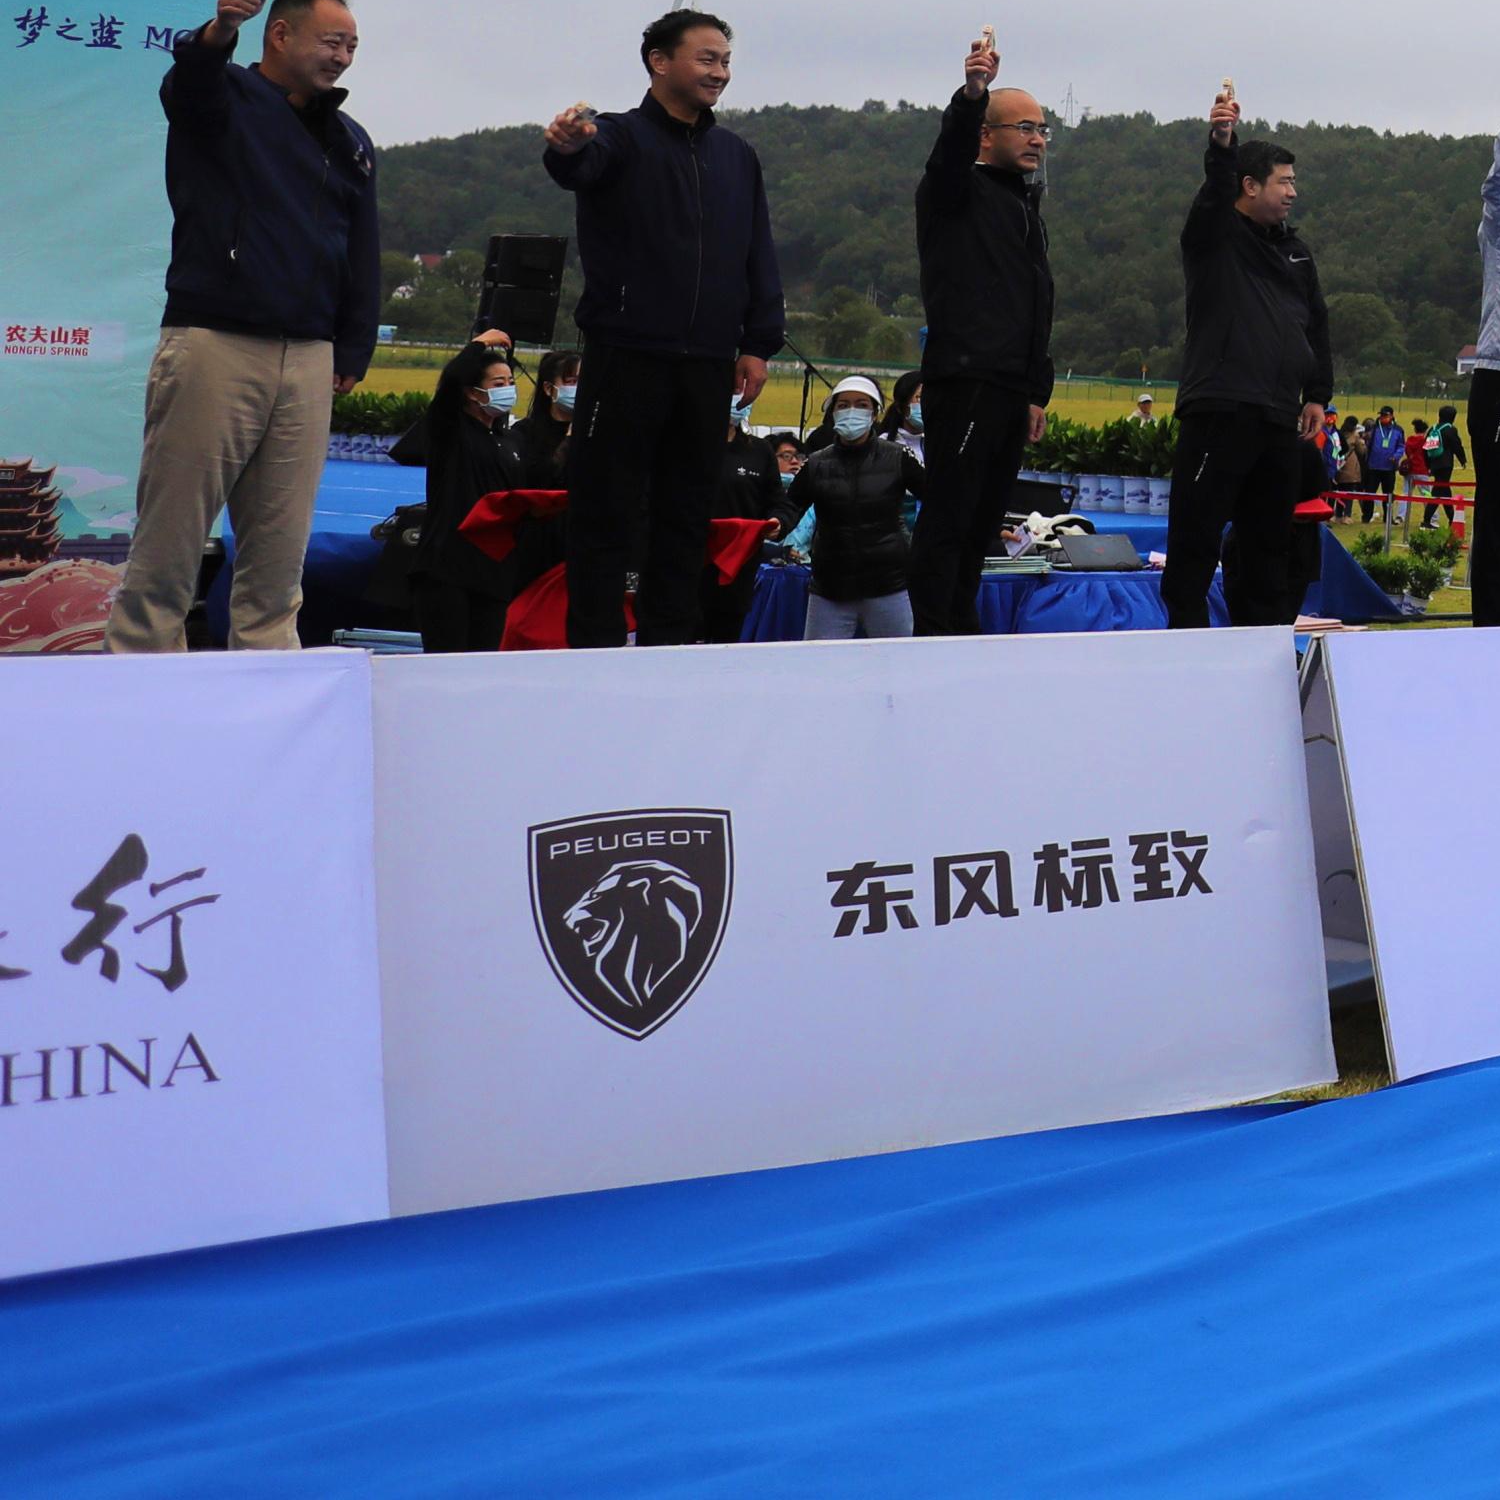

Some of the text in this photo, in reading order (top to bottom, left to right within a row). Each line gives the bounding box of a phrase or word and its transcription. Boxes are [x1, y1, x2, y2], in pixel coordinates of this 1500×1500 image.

[13, 5, 125, 49] 梦之蓝
[4, 345, 89, 357] NONGFU SPRING
[5, 324, 90, 345] 农夫山泉
[549, 828, 713, 860] PEUGEOT
[825, 829, 1215, 939] 东风标致
[0, 833, 222, 993] 行
